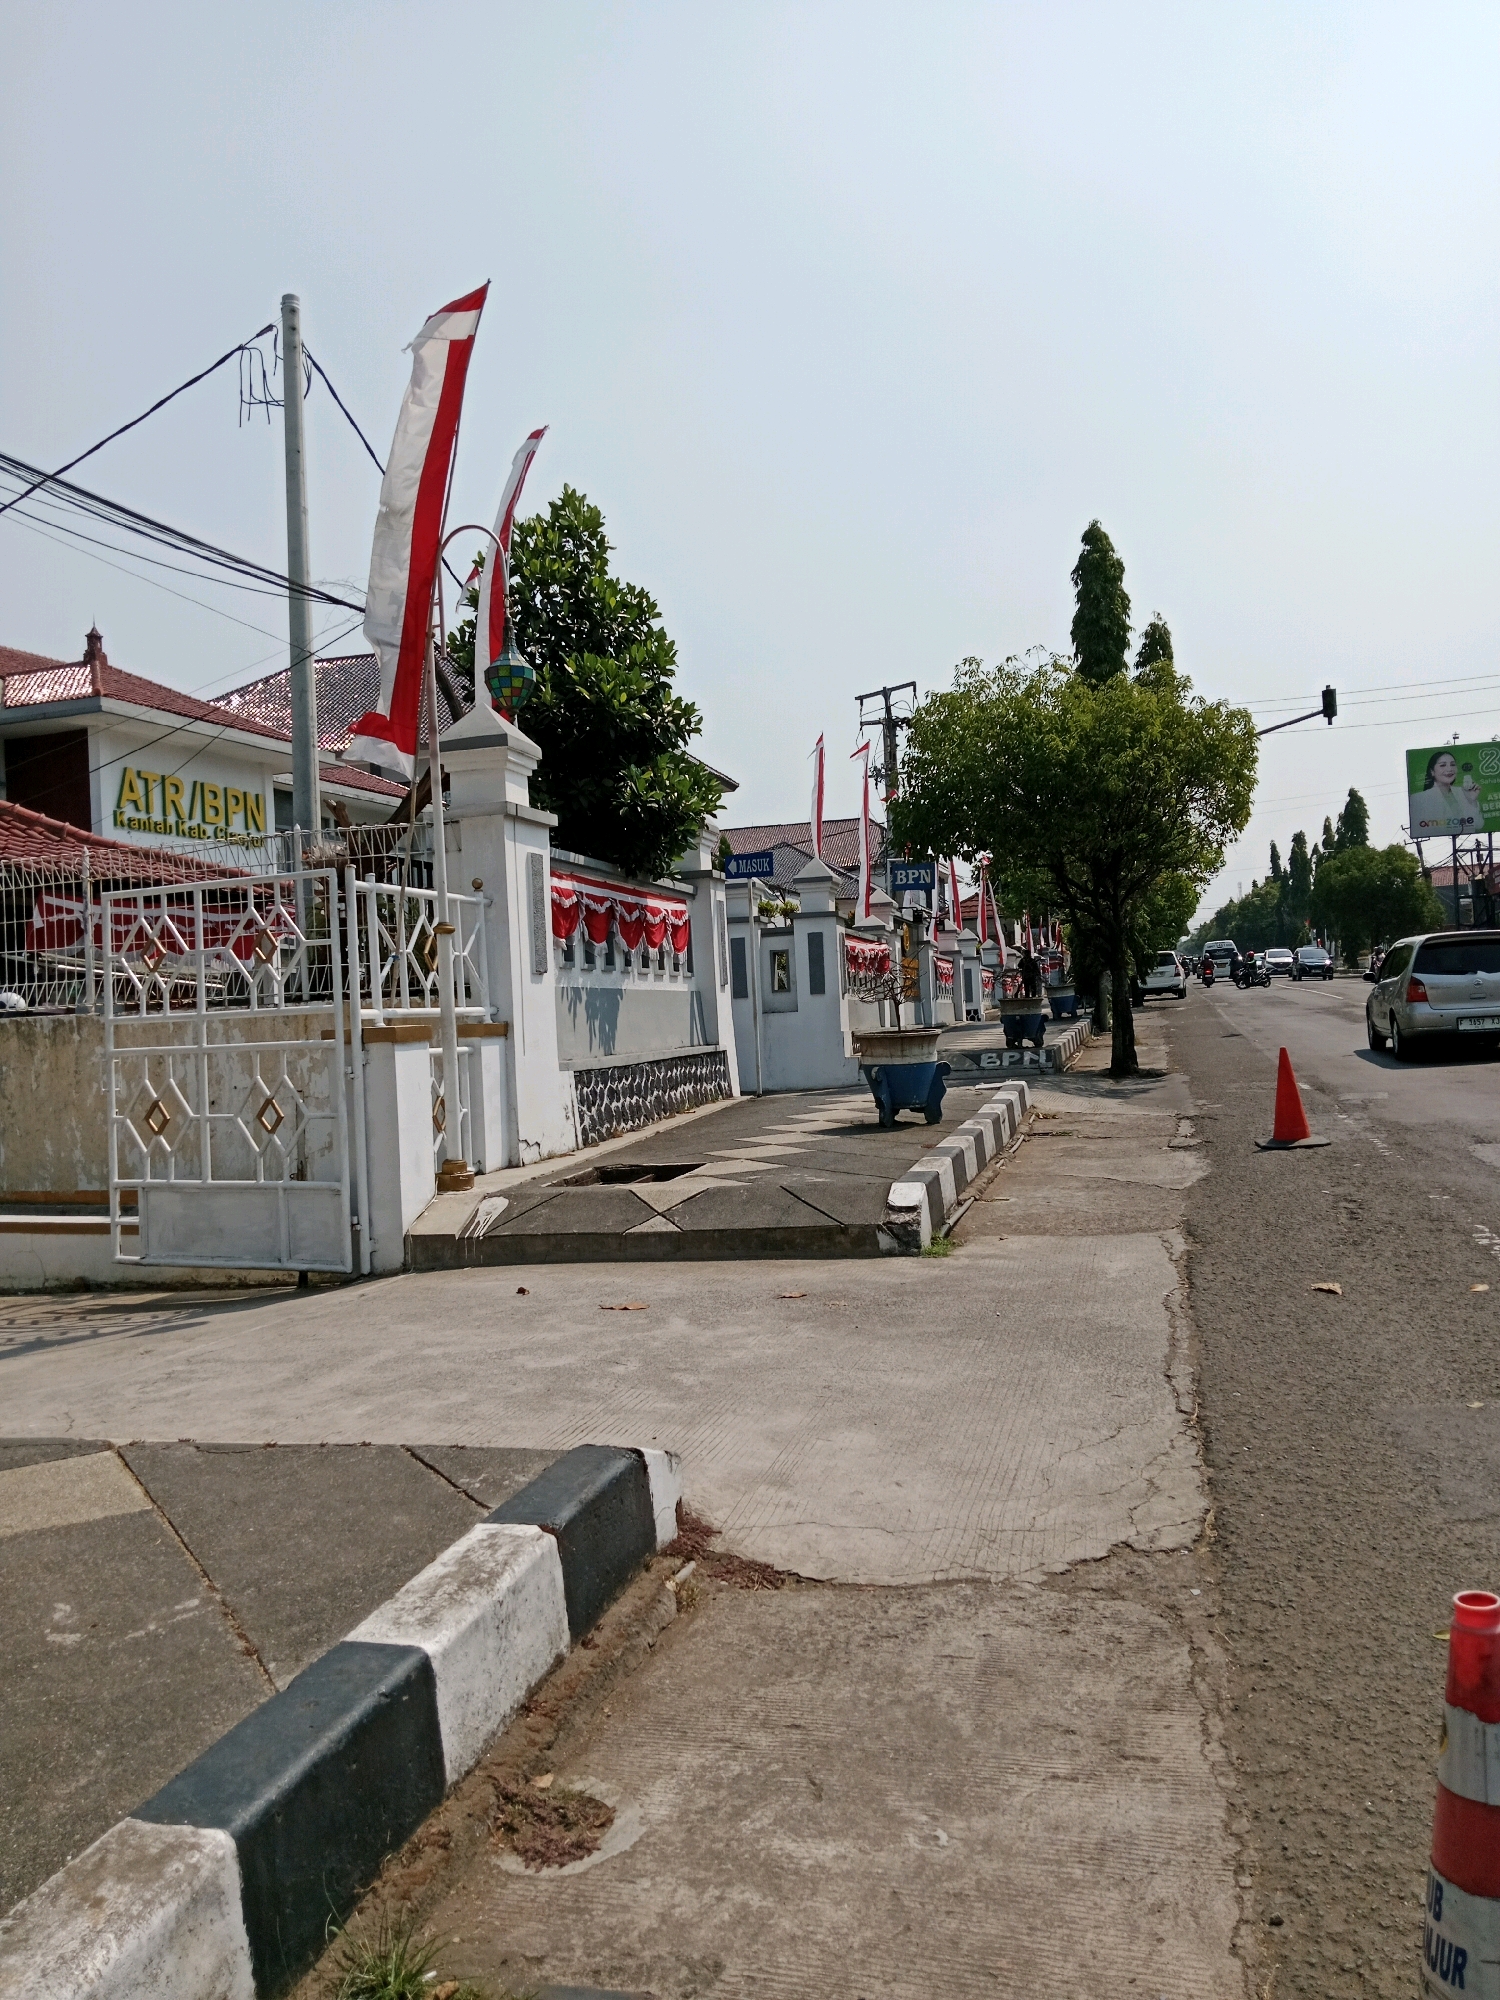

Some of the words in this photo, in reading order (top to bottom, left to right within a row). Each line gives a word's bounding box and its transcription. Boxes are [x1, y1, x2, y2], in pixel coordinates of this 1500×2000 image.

[117, 766, 266, 832] ATR/BPN
[113, 810, 174, 835] Kantah
[176, 819, 212, 840] Kab.
[738, 857, 771, 874] MASUK
[895, 869, 932, 885] BPN
[979, 1049, 1054, 1069] BPN
